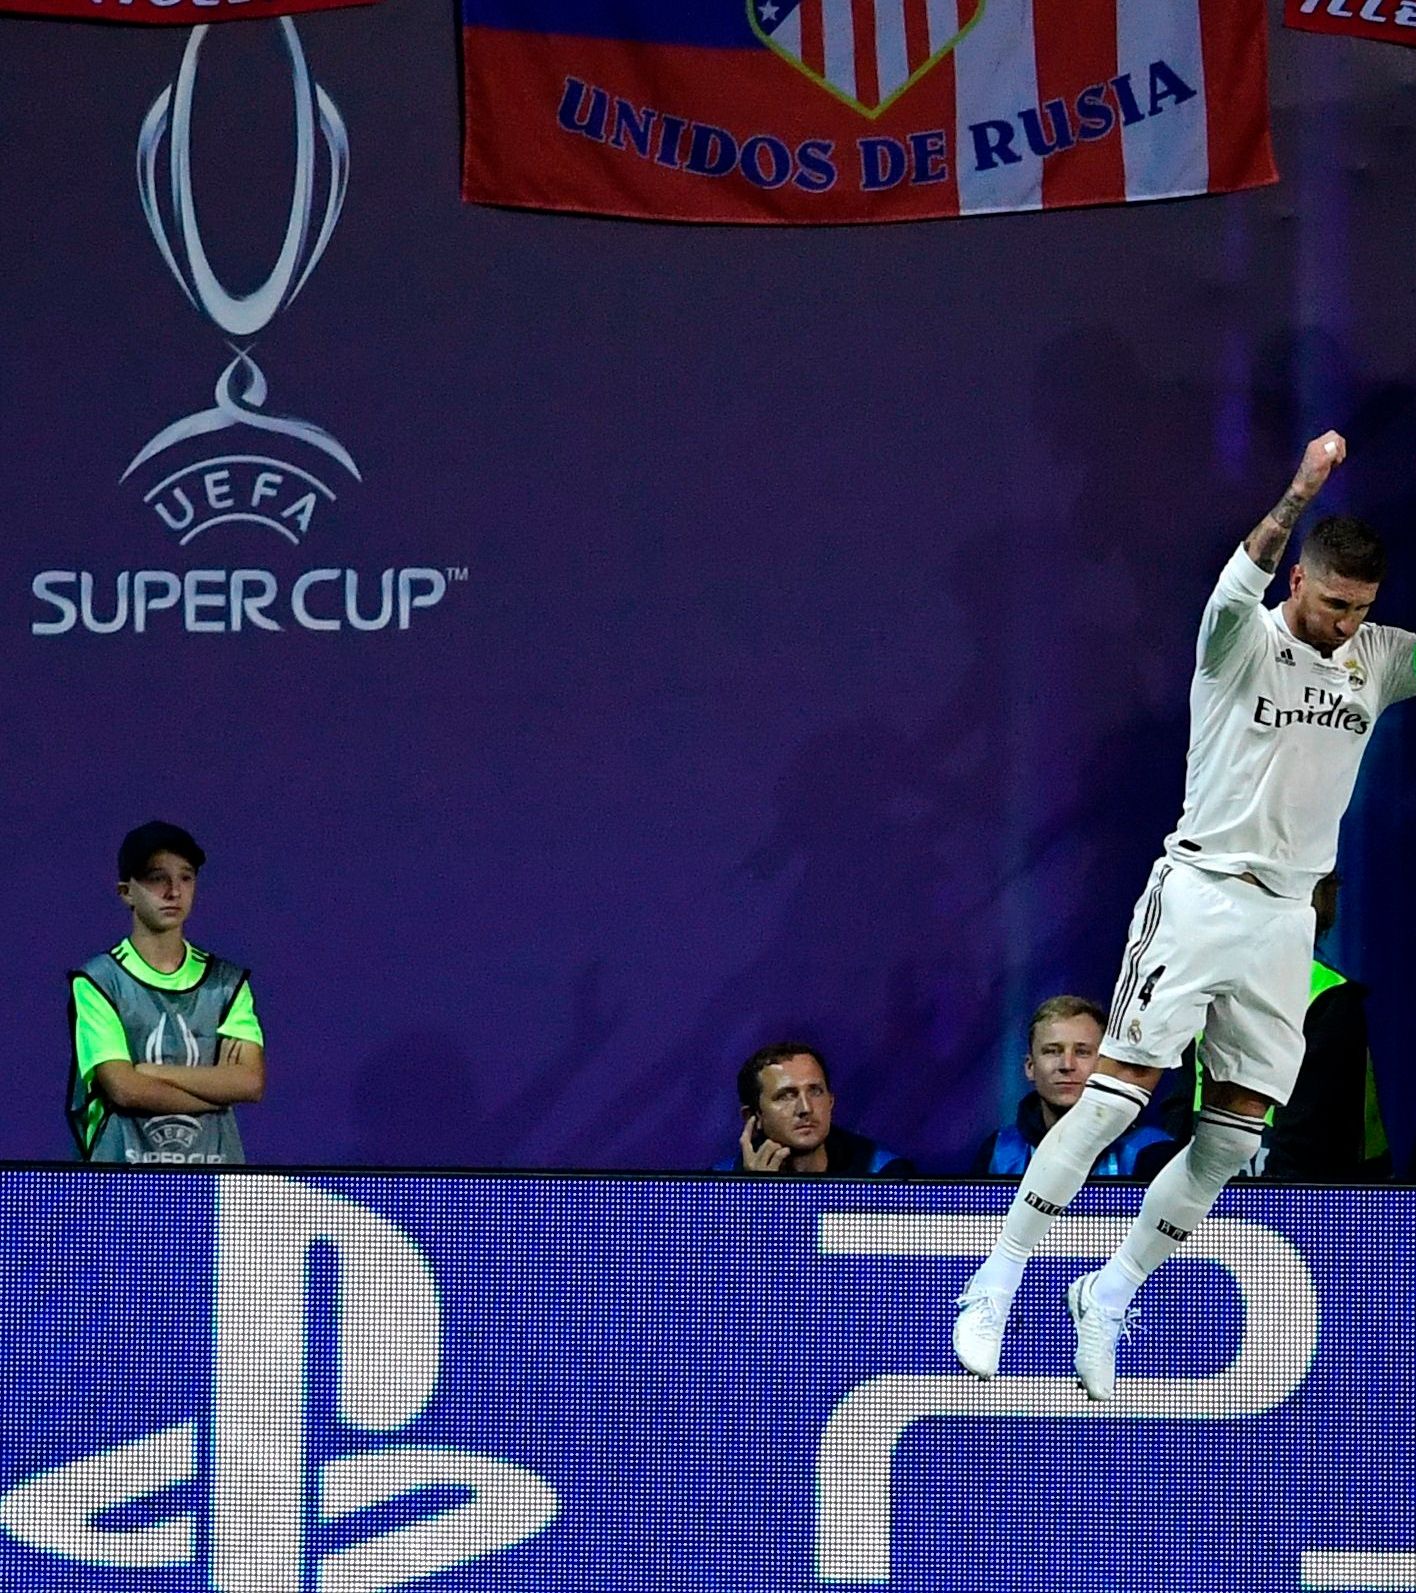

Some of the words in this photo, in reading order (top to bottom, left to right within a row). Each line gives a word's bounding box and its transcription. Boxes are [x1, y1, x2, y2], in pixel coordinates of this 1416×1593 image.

[557, 76, 838, 191] UNIDOS
[858, 130, 948, 192] DE
[969, 60, 1197, 171] RUSIA
[155, 470, 317, 532] UEFA
[32, 570, 286, 634] SUPER
[291, 568, 447, 631] CUP
[1254, 695, 1371, 735] Emirates
[1304, 686, 1343, 711] Fly
[1138, 964, 1167, 1012] 4
[152, 1128, 194, 1145] UEFA
